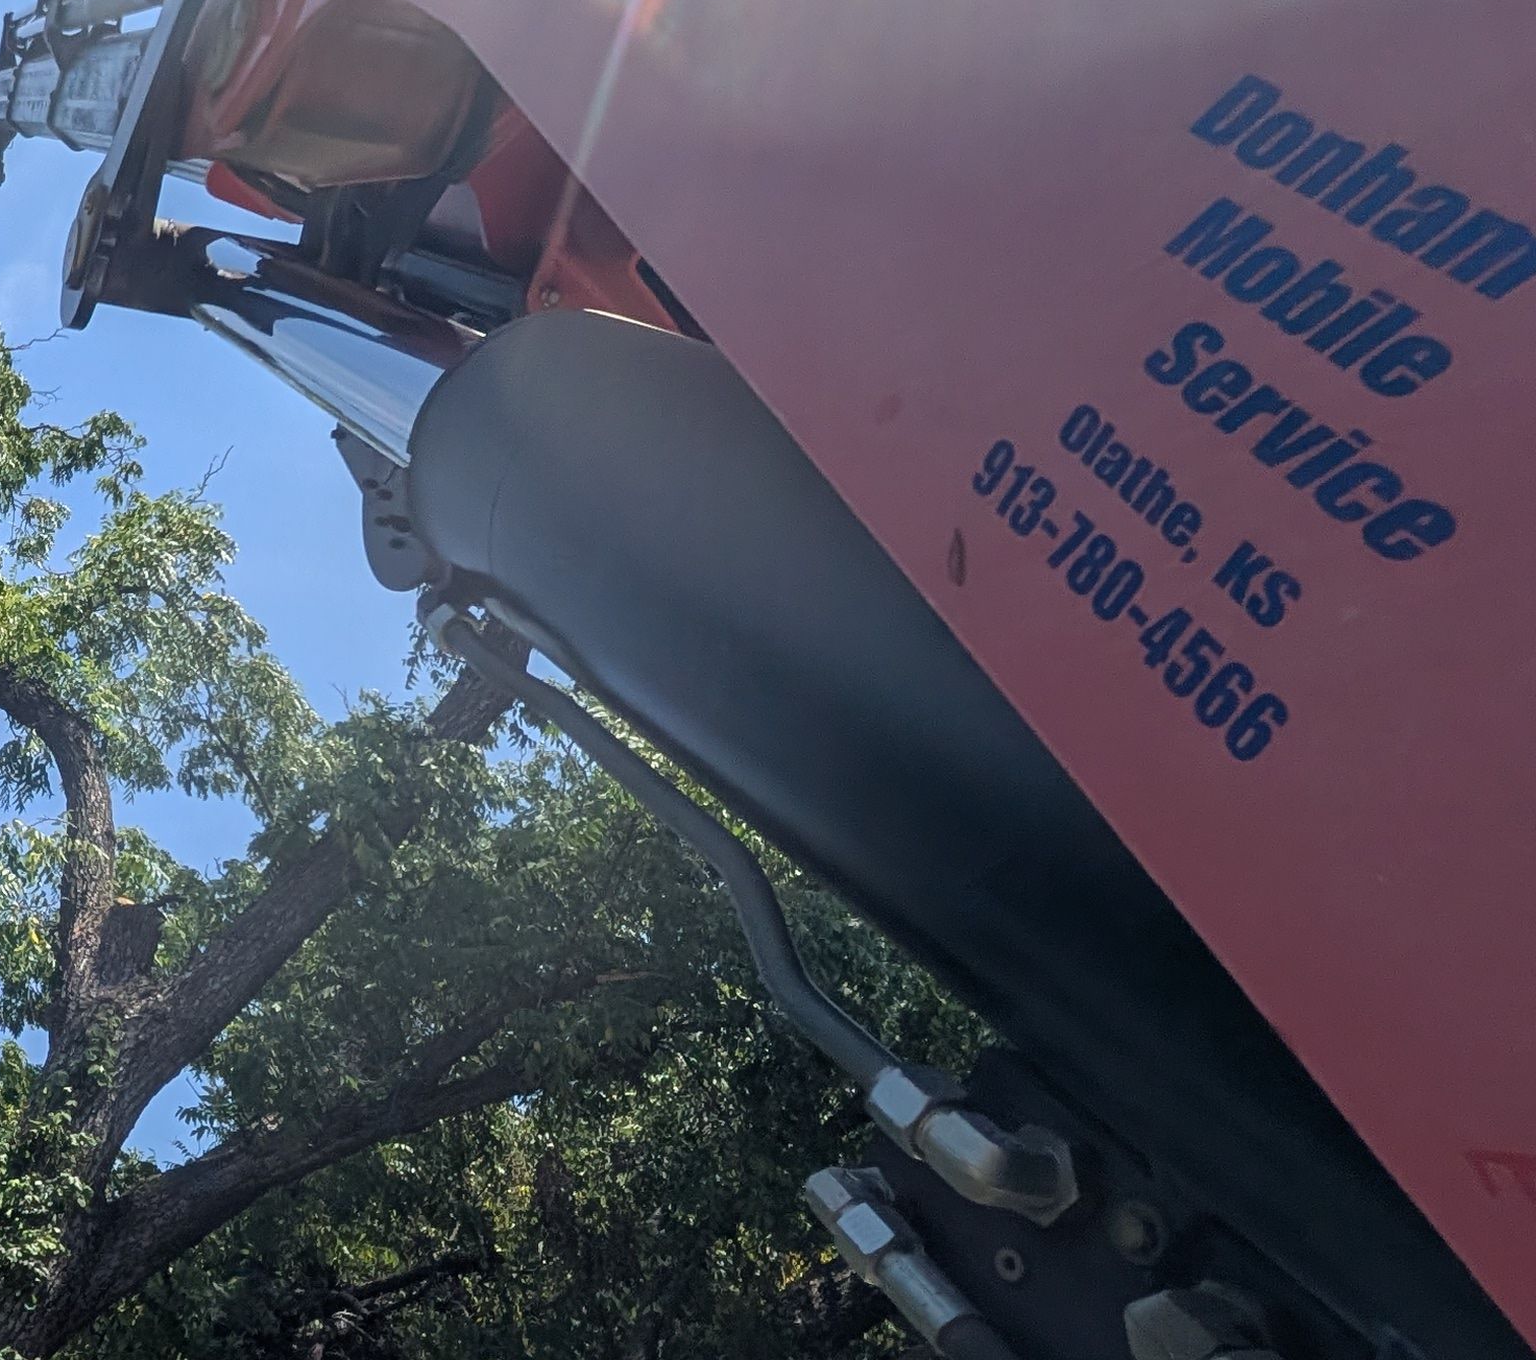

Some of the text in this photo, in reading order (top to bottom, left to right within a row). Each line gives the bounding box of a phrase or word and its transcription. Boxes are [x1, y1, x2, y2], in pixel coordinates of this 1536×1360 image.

[1162, 196, 1454, 399] Mobile
[1188, 73, 1536, 300] Donham
[1058, 404, 1303, 630] Olathe, KS
[1142, 321, 1458, 562] Service
[971, 439, 1290, 763] 913-780-4566
